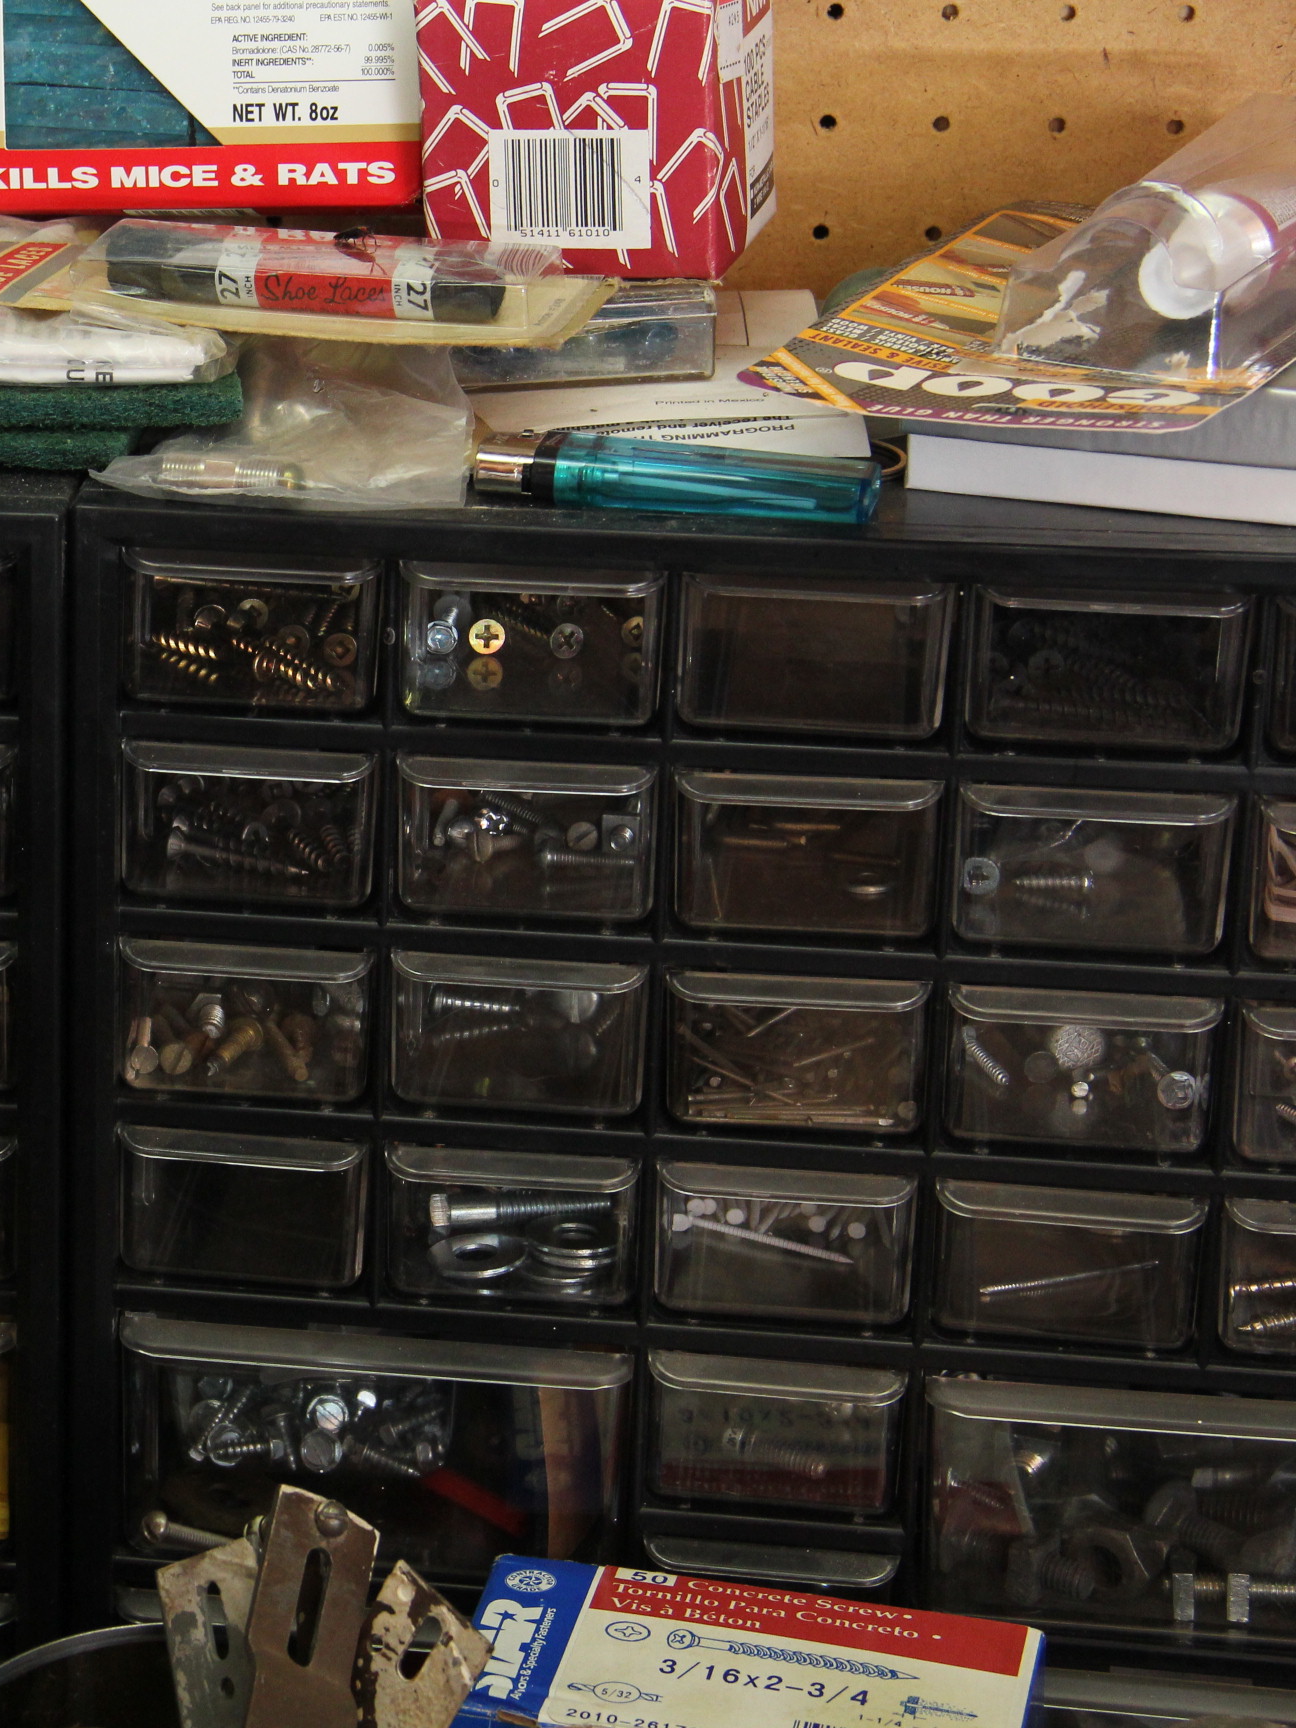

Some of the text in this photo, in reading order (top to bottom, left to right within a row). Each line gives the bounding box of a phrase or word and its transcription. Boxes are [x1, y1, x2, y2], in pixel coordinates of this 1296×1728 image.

[211, 0, 390, 12] See back panel for additional precautionary statements.
[211, 15, 296, 24] EPA REG. NO. 12455-79-3240
[320, 14, 333, 22] EPA
[334, 13, 347, 22] EST.
[347, 13, 359, 21] NO.
[232, 33, 308, 43] ACTIVE INGREDIENT:
[368, 43, 395, 52] 0.005%
[279, 45, 298, 54] (CAS
[299, 46, 310, 54] No.
[310, 44, 351, 53] 28772-56-7)
[232, 58, 254, 67] INERT
[364, 56, 395, 64] 99.995%
[232, 70, 256, 79] TOTAL
[361, 67, 395, 76] 100.000%
[267, 85, 308, 94] Denatonium
[308, 84, 340, 93] Benzoate
[745, 64, 764, 103] CABLE
[233, 102, 339, 123] NET WT. 8oz
[746, 82, 770, 129] STAPLES
[110, 164, 219, 189] MICE
[230, 163, 265, 187] &
[277, 160, 397, 186] RATS
[492, 175, 642, 238] 0 51411 61010 4
[218, 270, 242, 301] 27
[243, 276, 254, 298] INCH
[261, 273, 385, 305] Shoe Laces
[394, 284, 403, 307] INCH
[406, 280, 430, 312] 27
[826, 322, 865, 334] METAL
[831, 318, 919, 345] VINYL WOOD
[808, 332, 882, 357] SEALANT
[820, 326, 917, 354] FABRIC GLASS
[884, 346, 897, 360] &
[834, 361, 1200, 407] GOOP
[655, 398, 700, 406] Printed
[718, 396, 766, 404] Mexico
[656, 422, 687, 431] and
[692, 417, 773, 428] receiver
[867, 404, 1168, 430] STRONGER THAN GLUE
[662, 423, 796, 442] PROGRAMMING
[630, 1571, 899, 1620] 50 Concrete Screw
[611, 1597, 762, 1630] Vis à Béton
[612, 1583, 919, 1640] Tornillo Para Concreto
[523, 1638, 544, 1670] Specialty
[535, 1607, 557, 1640] Fasteners
[658, 1658, 869, 1707] 3/16x2-3/4
[600, 1687, 633, 1700] 5/32
[858, 1713, 903, 1727] 1-1/4
